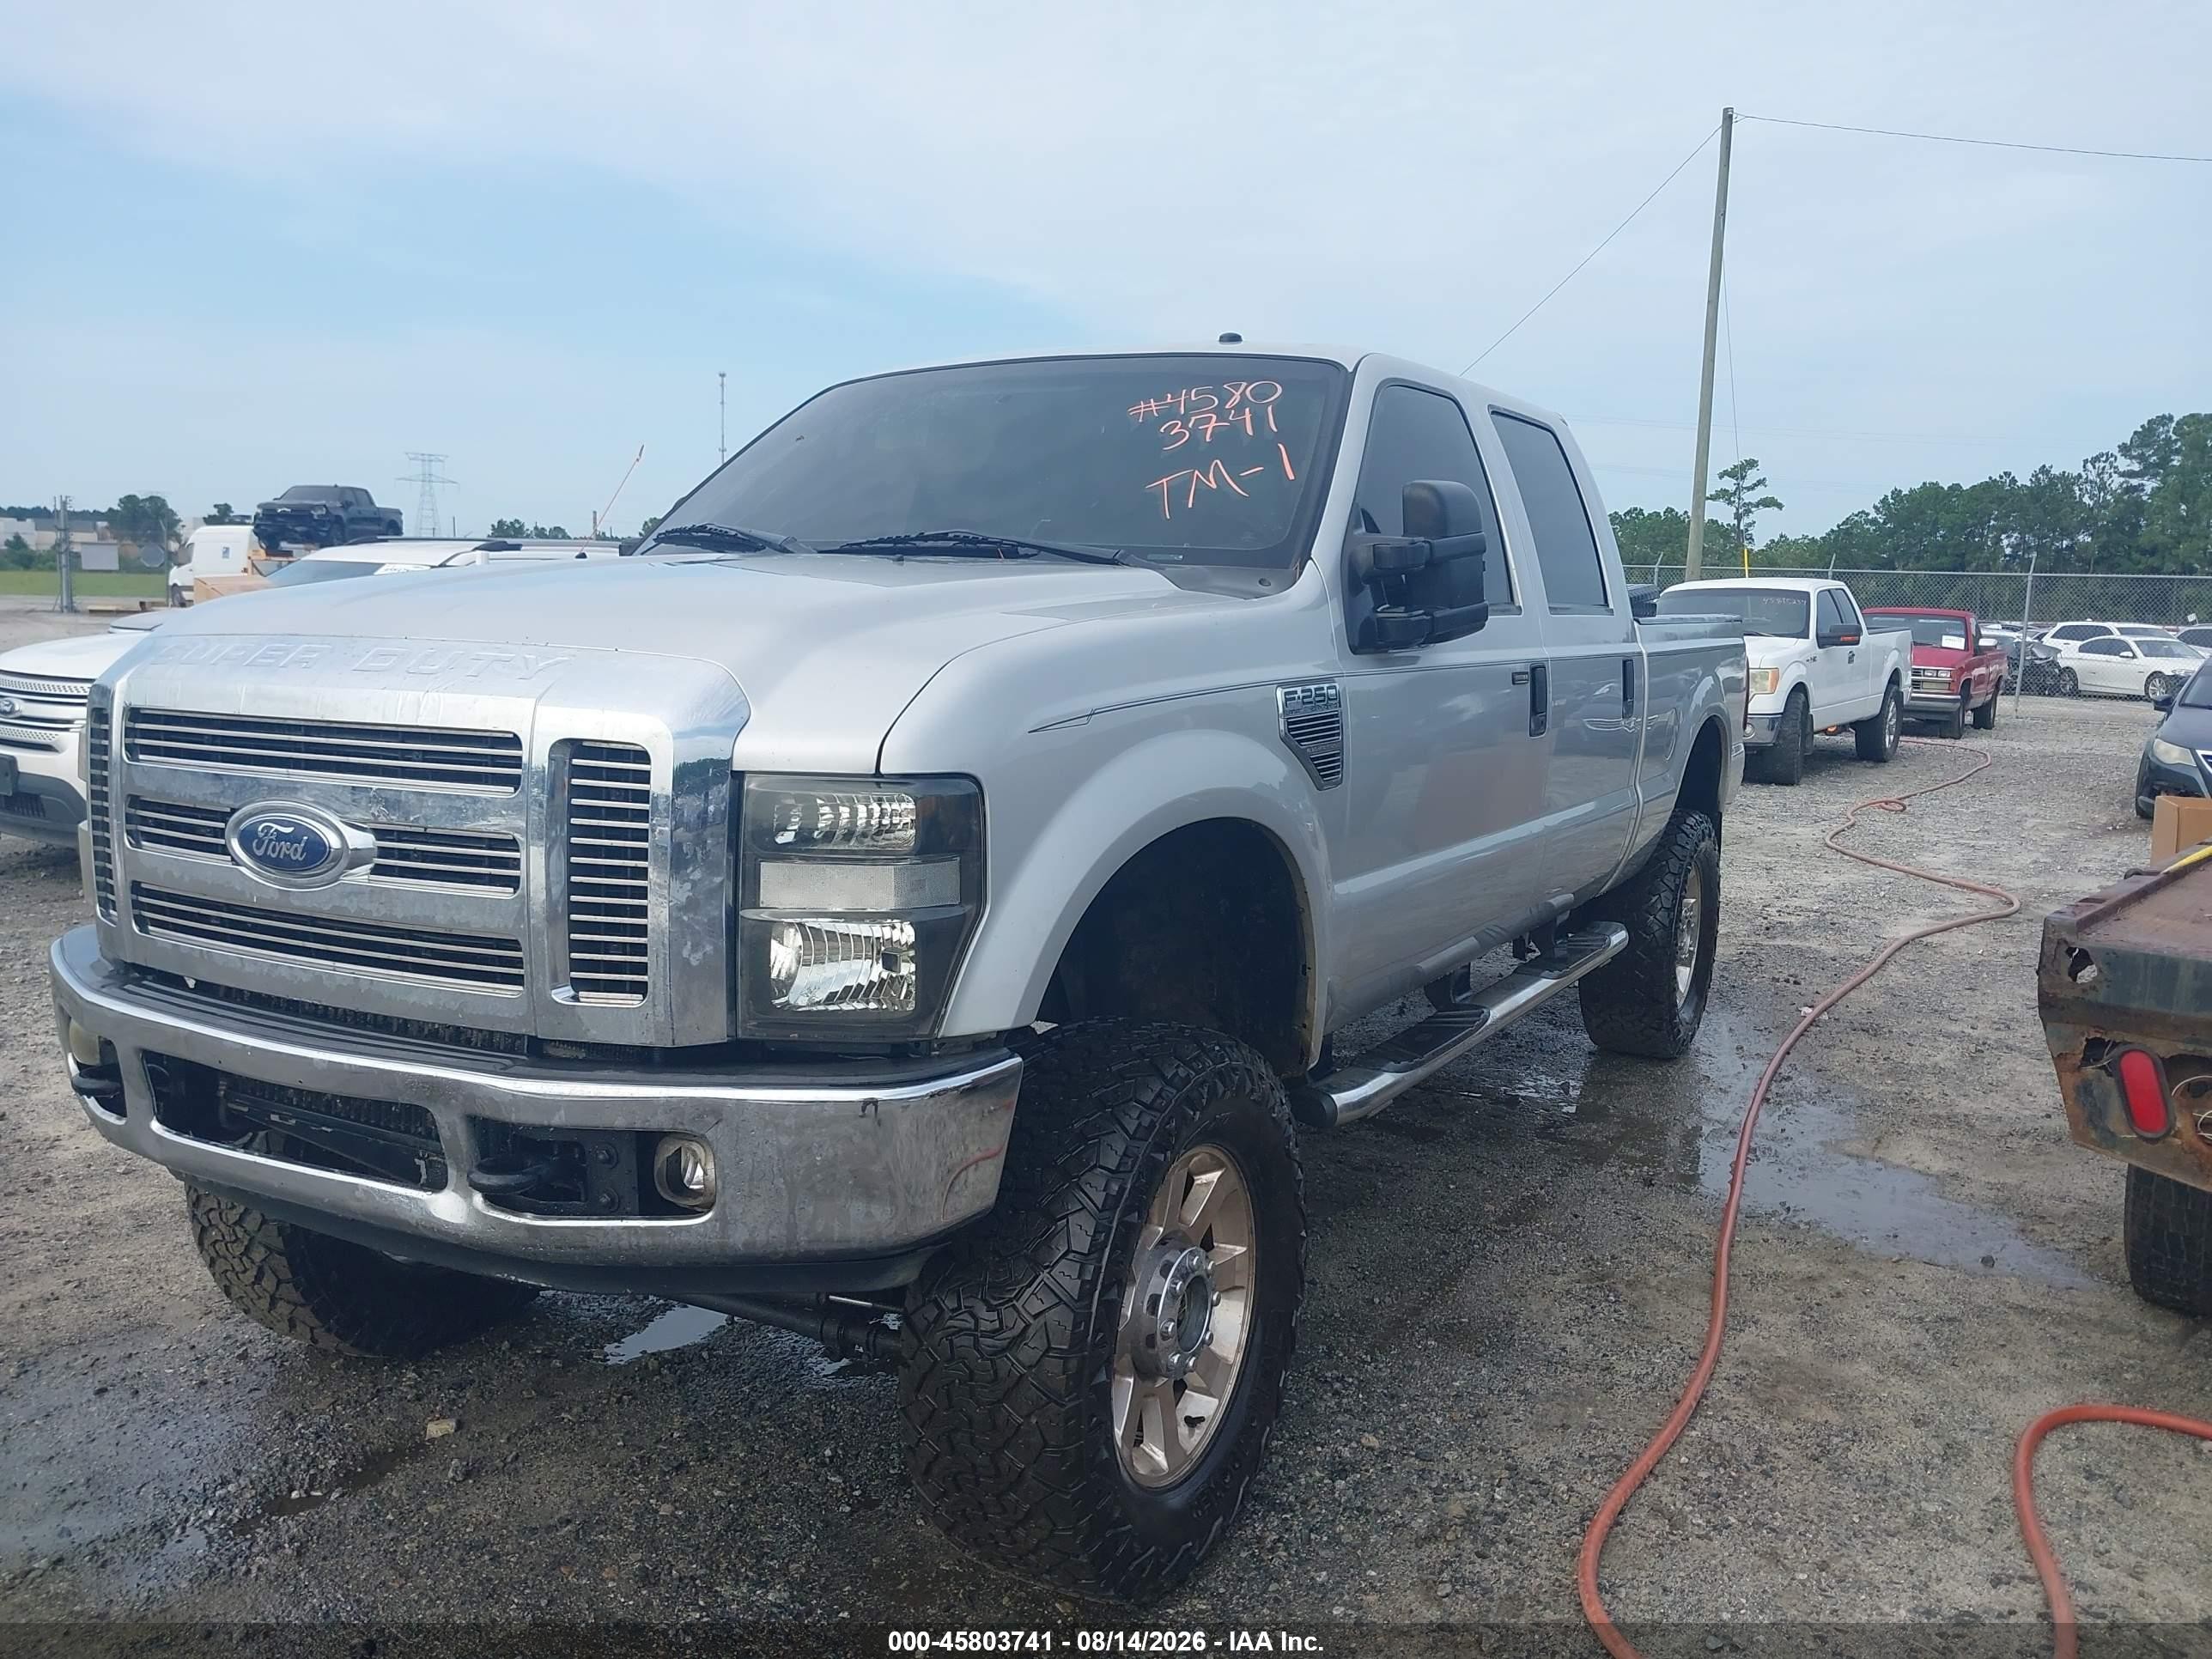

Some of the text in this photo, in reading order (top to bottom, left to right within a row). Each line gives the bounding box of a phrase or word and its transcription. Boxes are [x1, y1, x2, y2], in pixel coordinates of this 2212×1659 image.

[1127, 380, 1283, 422] #4580
[1160, 405, 1278, 450] 3741
[150, 642, 572, 680] SUPER DUTY
[252, 822, 309, 861] Ford
